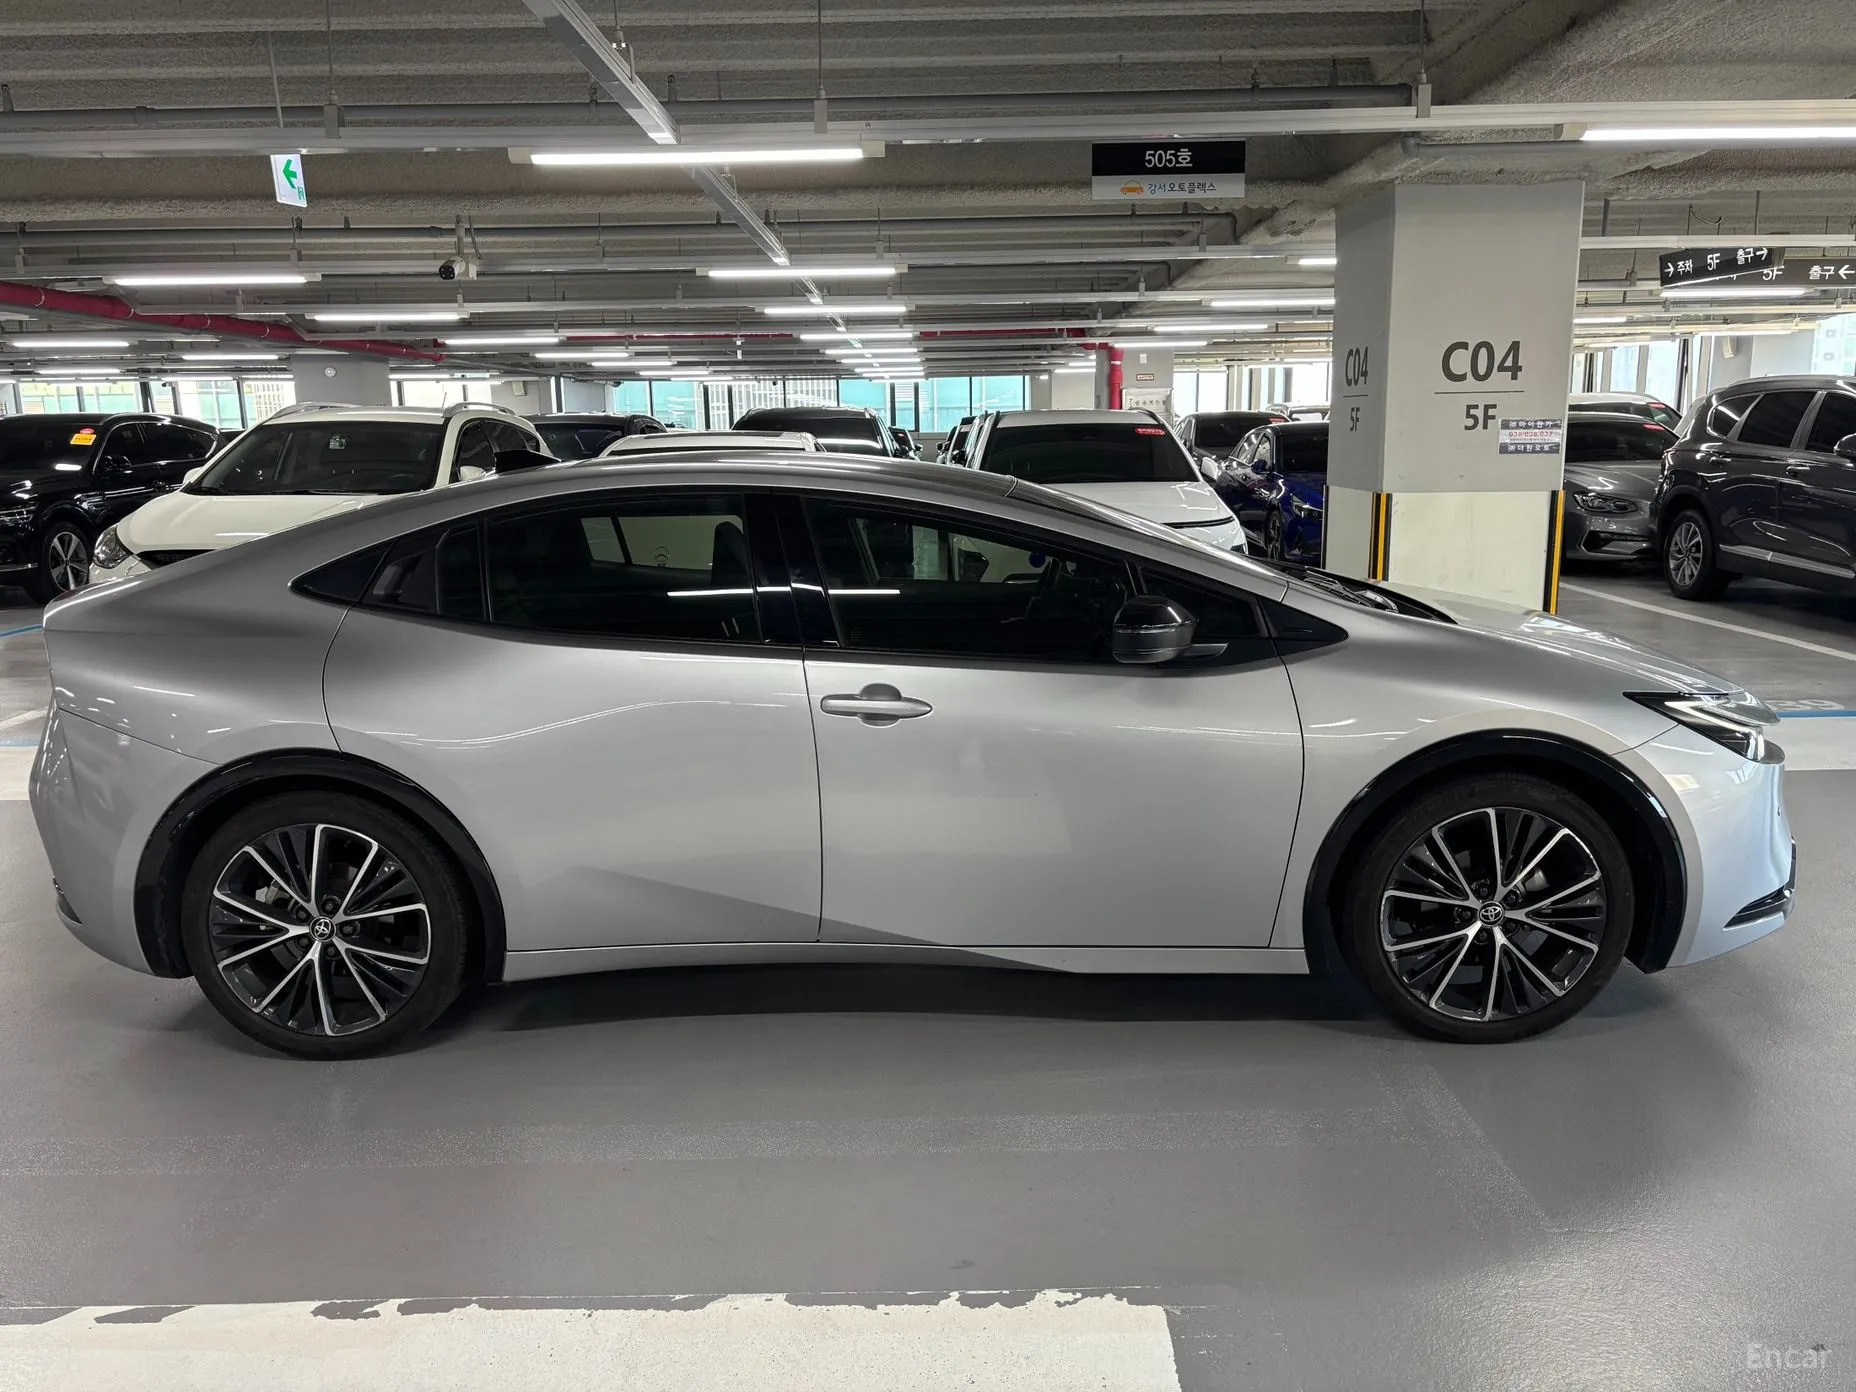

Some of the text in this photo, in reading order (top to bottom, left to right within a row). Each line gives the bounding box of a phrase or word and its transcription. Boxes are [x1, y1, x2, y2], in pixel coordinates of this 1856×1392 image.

[1145, 148, 1193, 168] 505호
[1148, 181, 1217, 195] 강서오토플렉스
[1677, 247, 1754, 276] 주차 5F 출구
[1809, 265, 1835, 280] 출구
[1345, 346, 1369, 387] C04
[1441, 340, 1523, 382] C04
[1350, 406, 1361, 433] 5F
[1464, 404, 1498, 431] 5F
